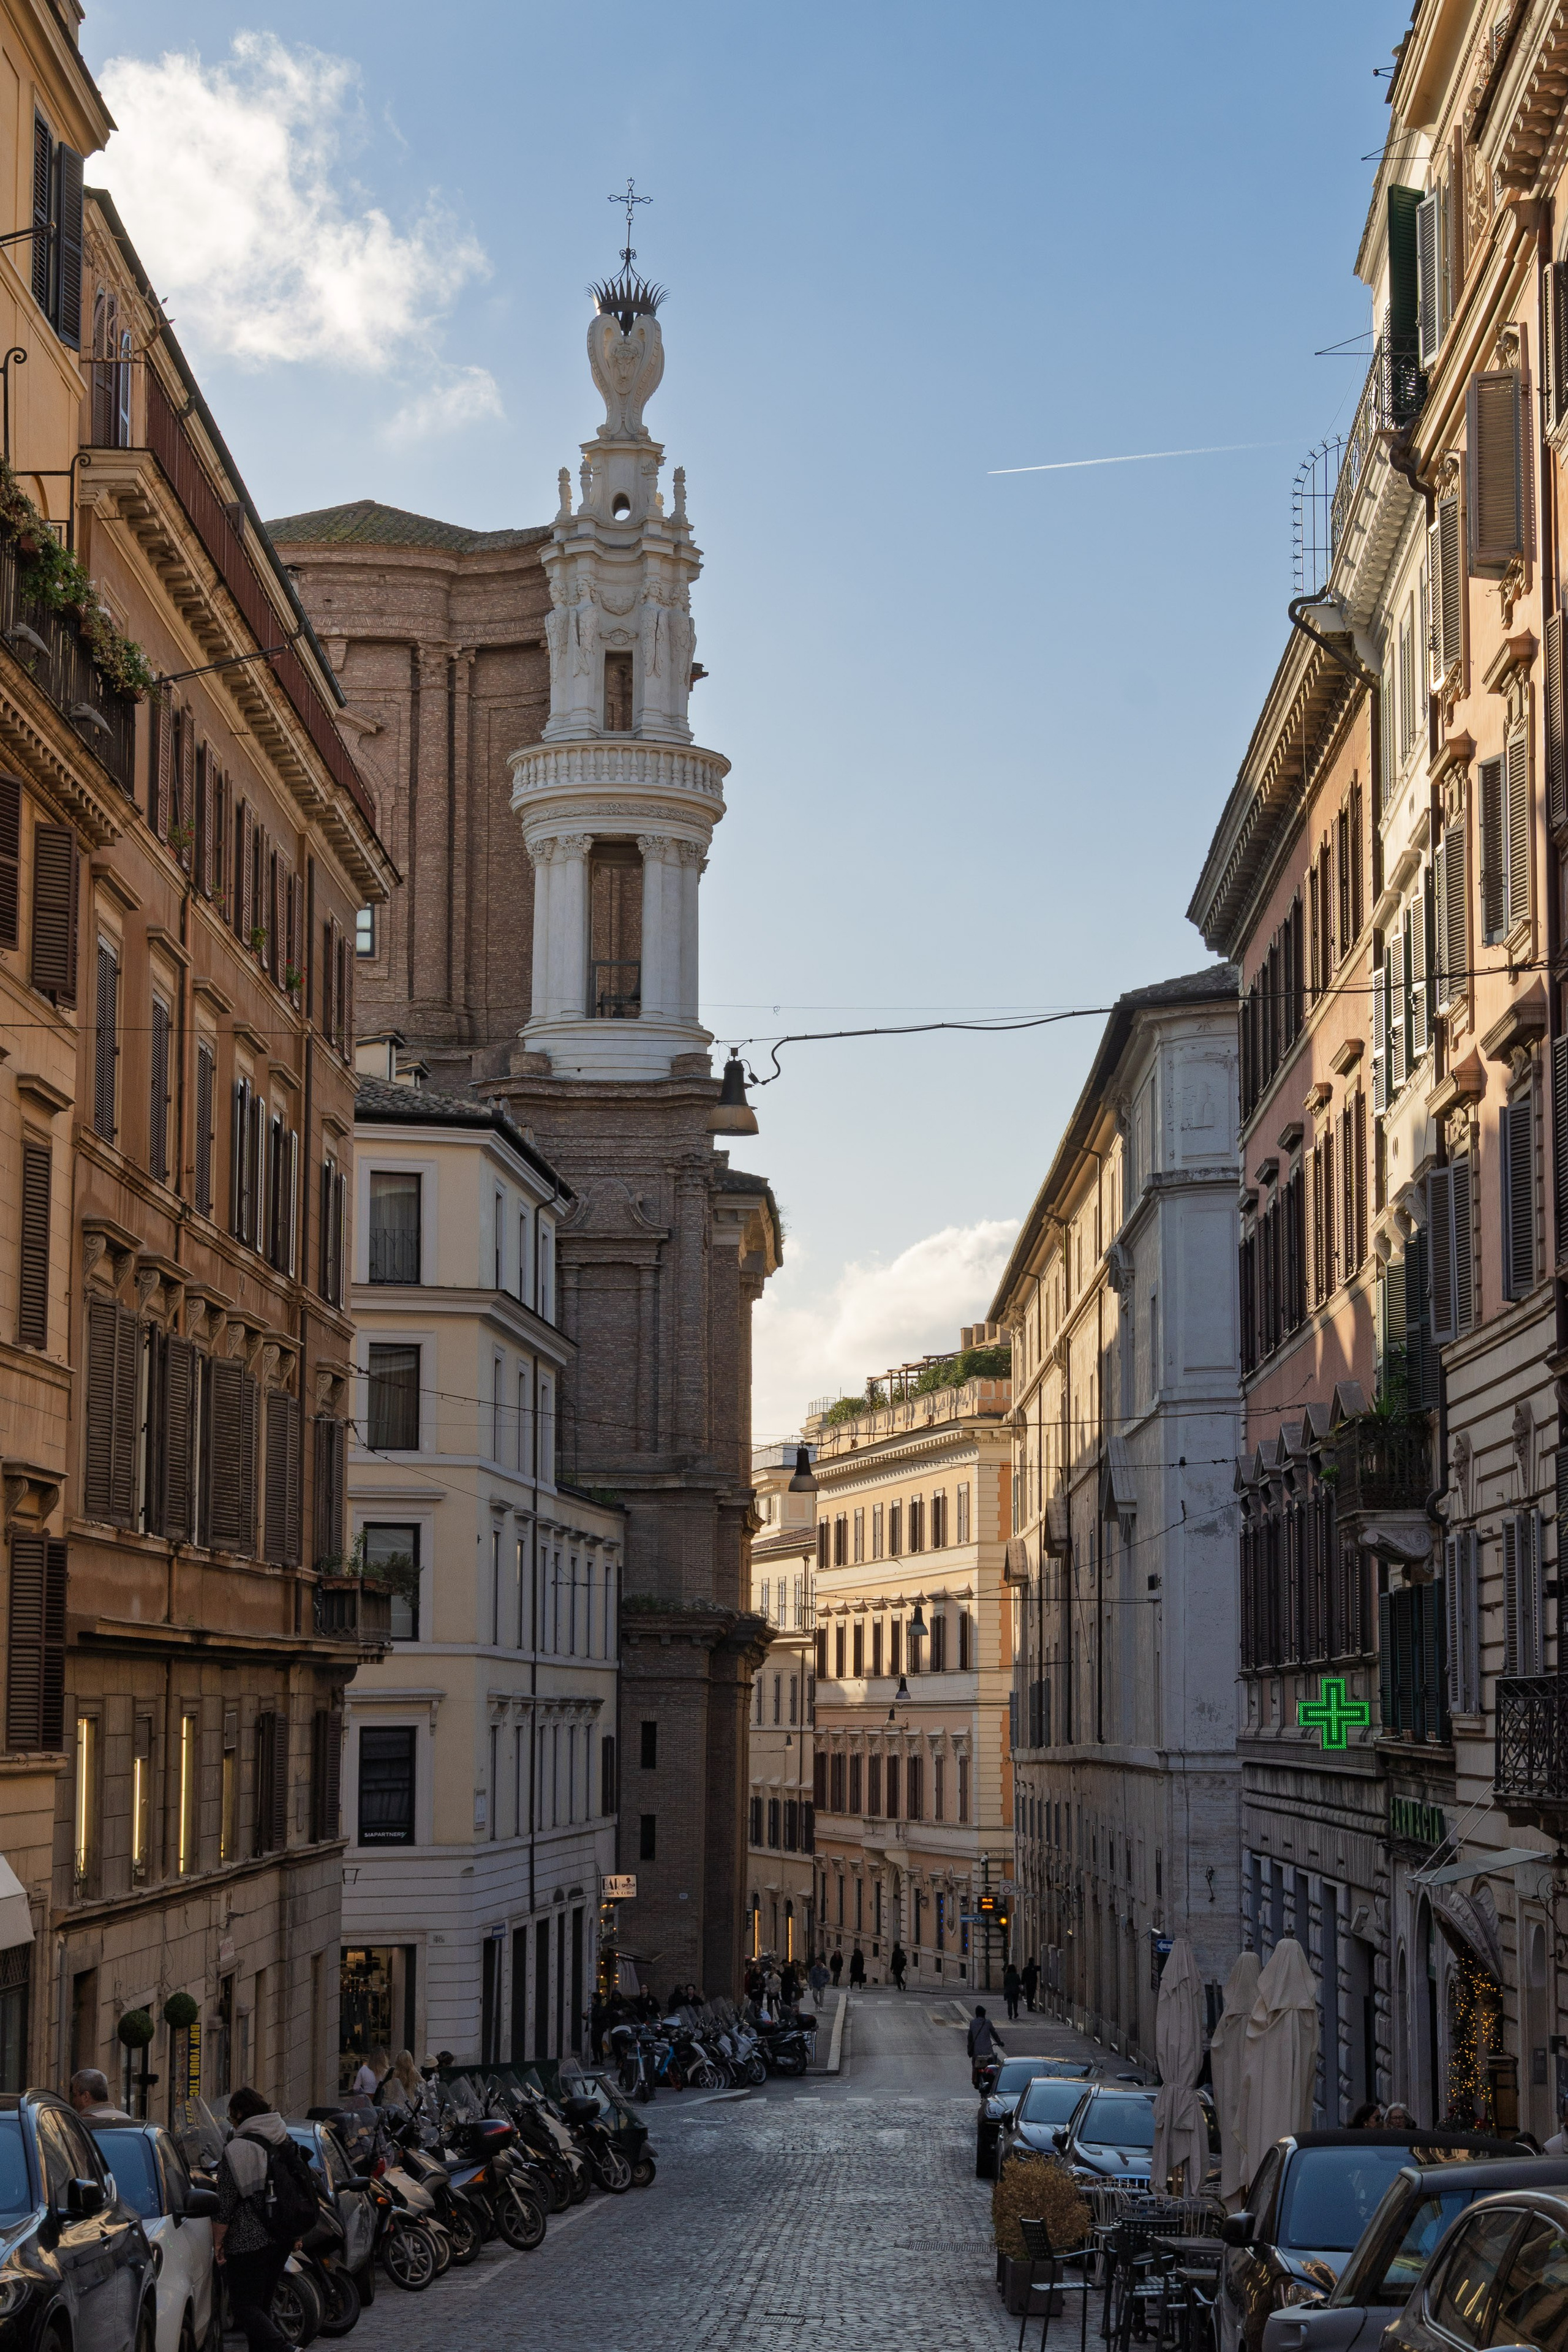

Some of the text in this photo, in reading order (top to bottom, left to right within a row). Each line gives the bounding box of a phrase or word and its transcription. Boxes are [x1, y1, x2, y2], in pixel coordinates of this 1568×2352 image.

[1390, 1797, 1442, 1845] FARMACIA
[602, 1878, 620, 1890] BAR
[190, 2024, 200, 2046] BUY
[189, 2048, 200, 2076] YOUR
